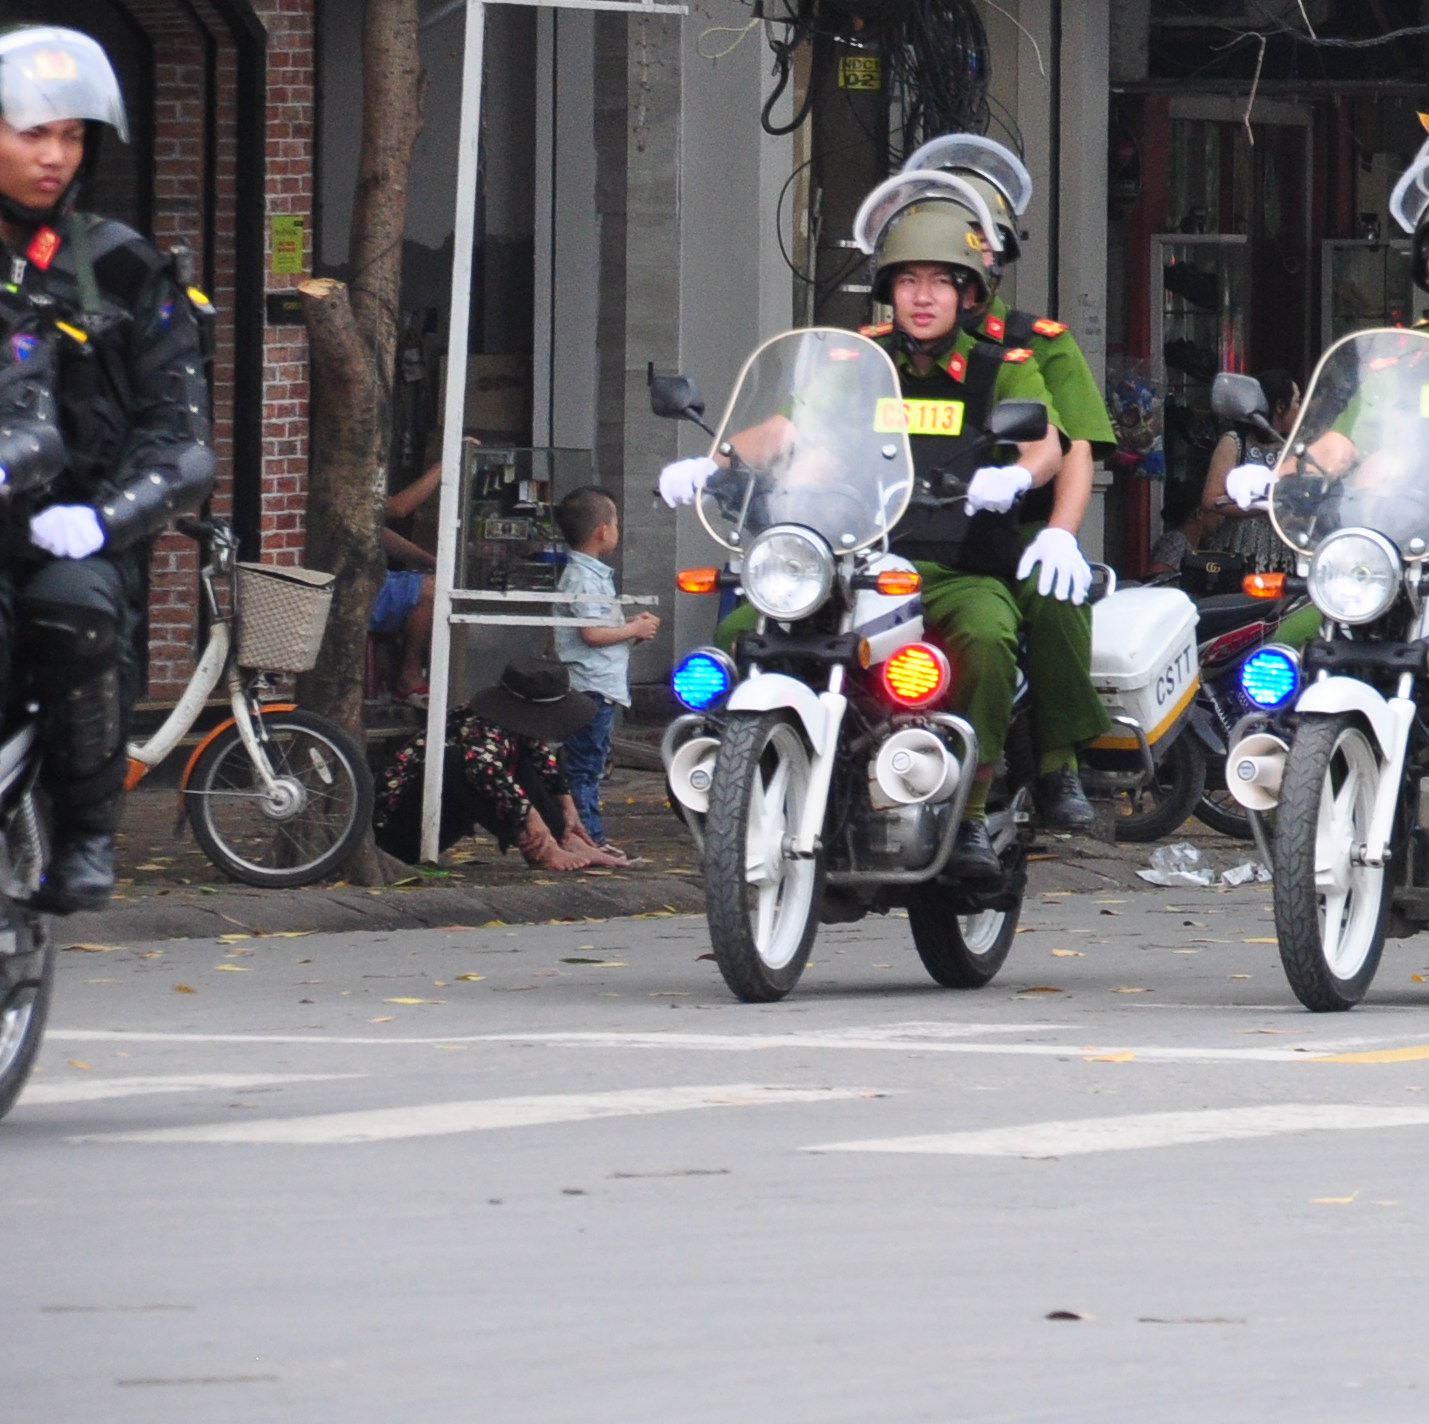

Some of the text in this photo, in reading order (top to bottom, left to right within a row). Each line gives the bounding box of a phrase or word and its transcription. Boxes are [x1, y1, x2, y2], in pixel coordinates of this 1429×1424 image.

[881, 402, 954, 430] CS 113
[1156, 644, 1191, 706] CSTT
